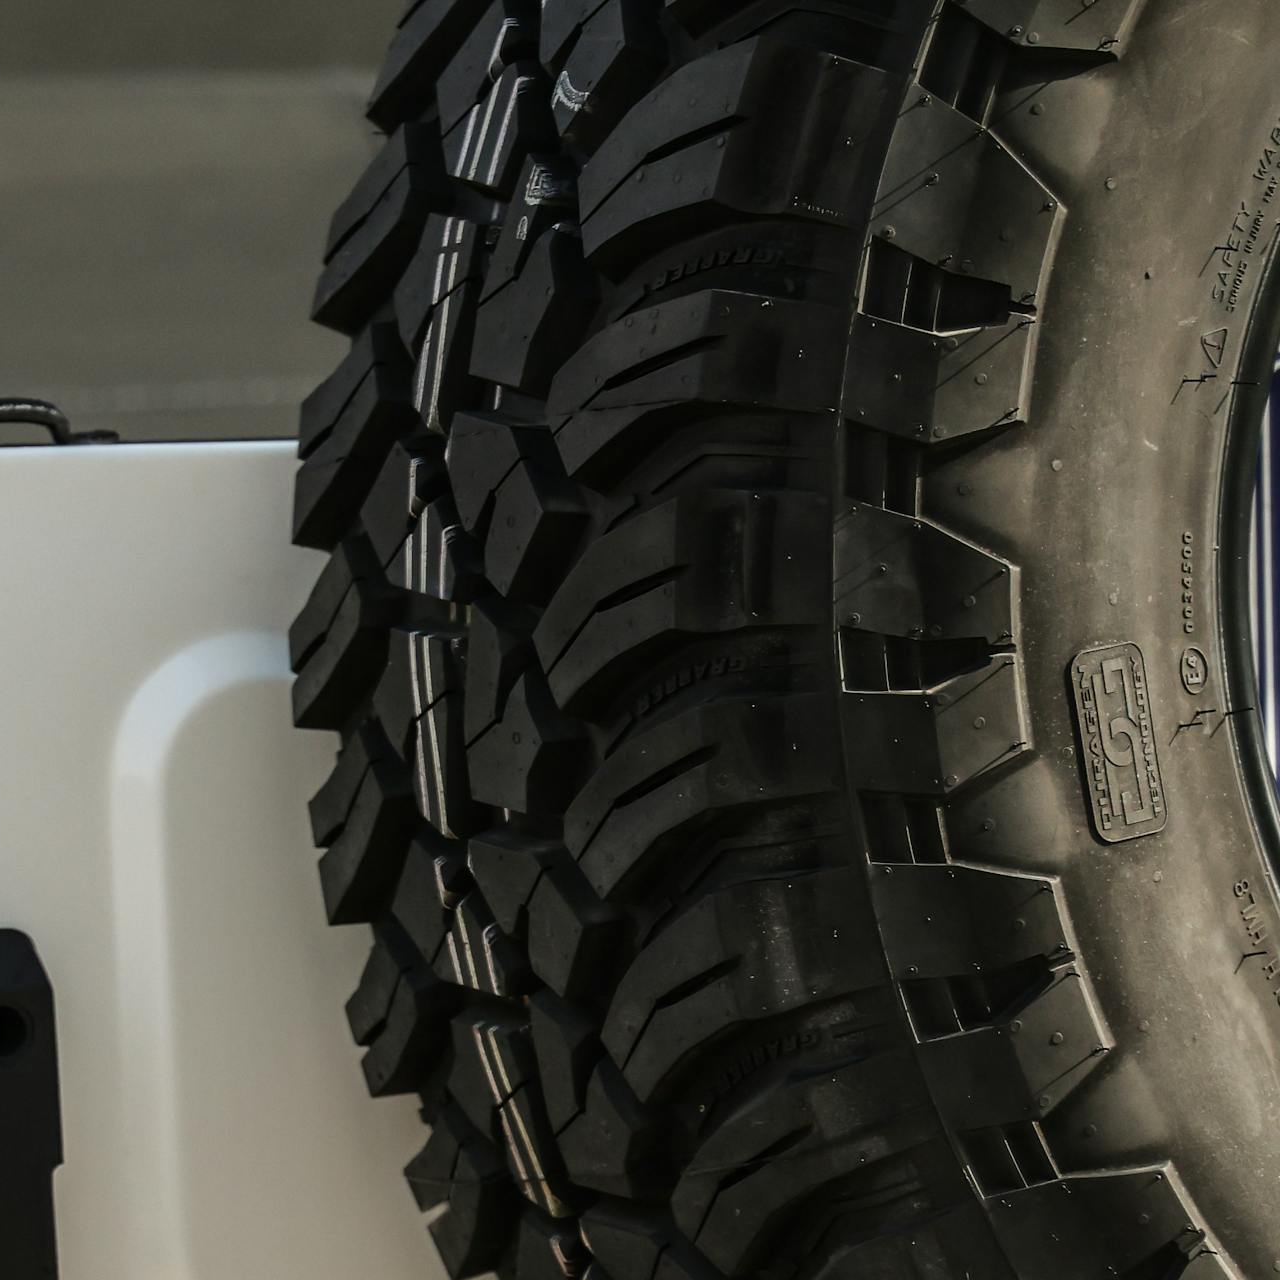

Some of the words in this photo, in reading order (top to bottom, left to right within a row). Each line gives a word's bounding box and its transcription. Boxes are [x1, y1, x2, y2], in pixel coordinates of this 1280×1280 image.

[1212, 202, 1251, 301] SAFETY
[1254, 113, 1280, 182] WAR
[1181, 530, 1195, 634] 0034500
[1076, 664, 1113, 830] DURAGEN
[1130, 655, 1163, 817] TECHNOLOGY
